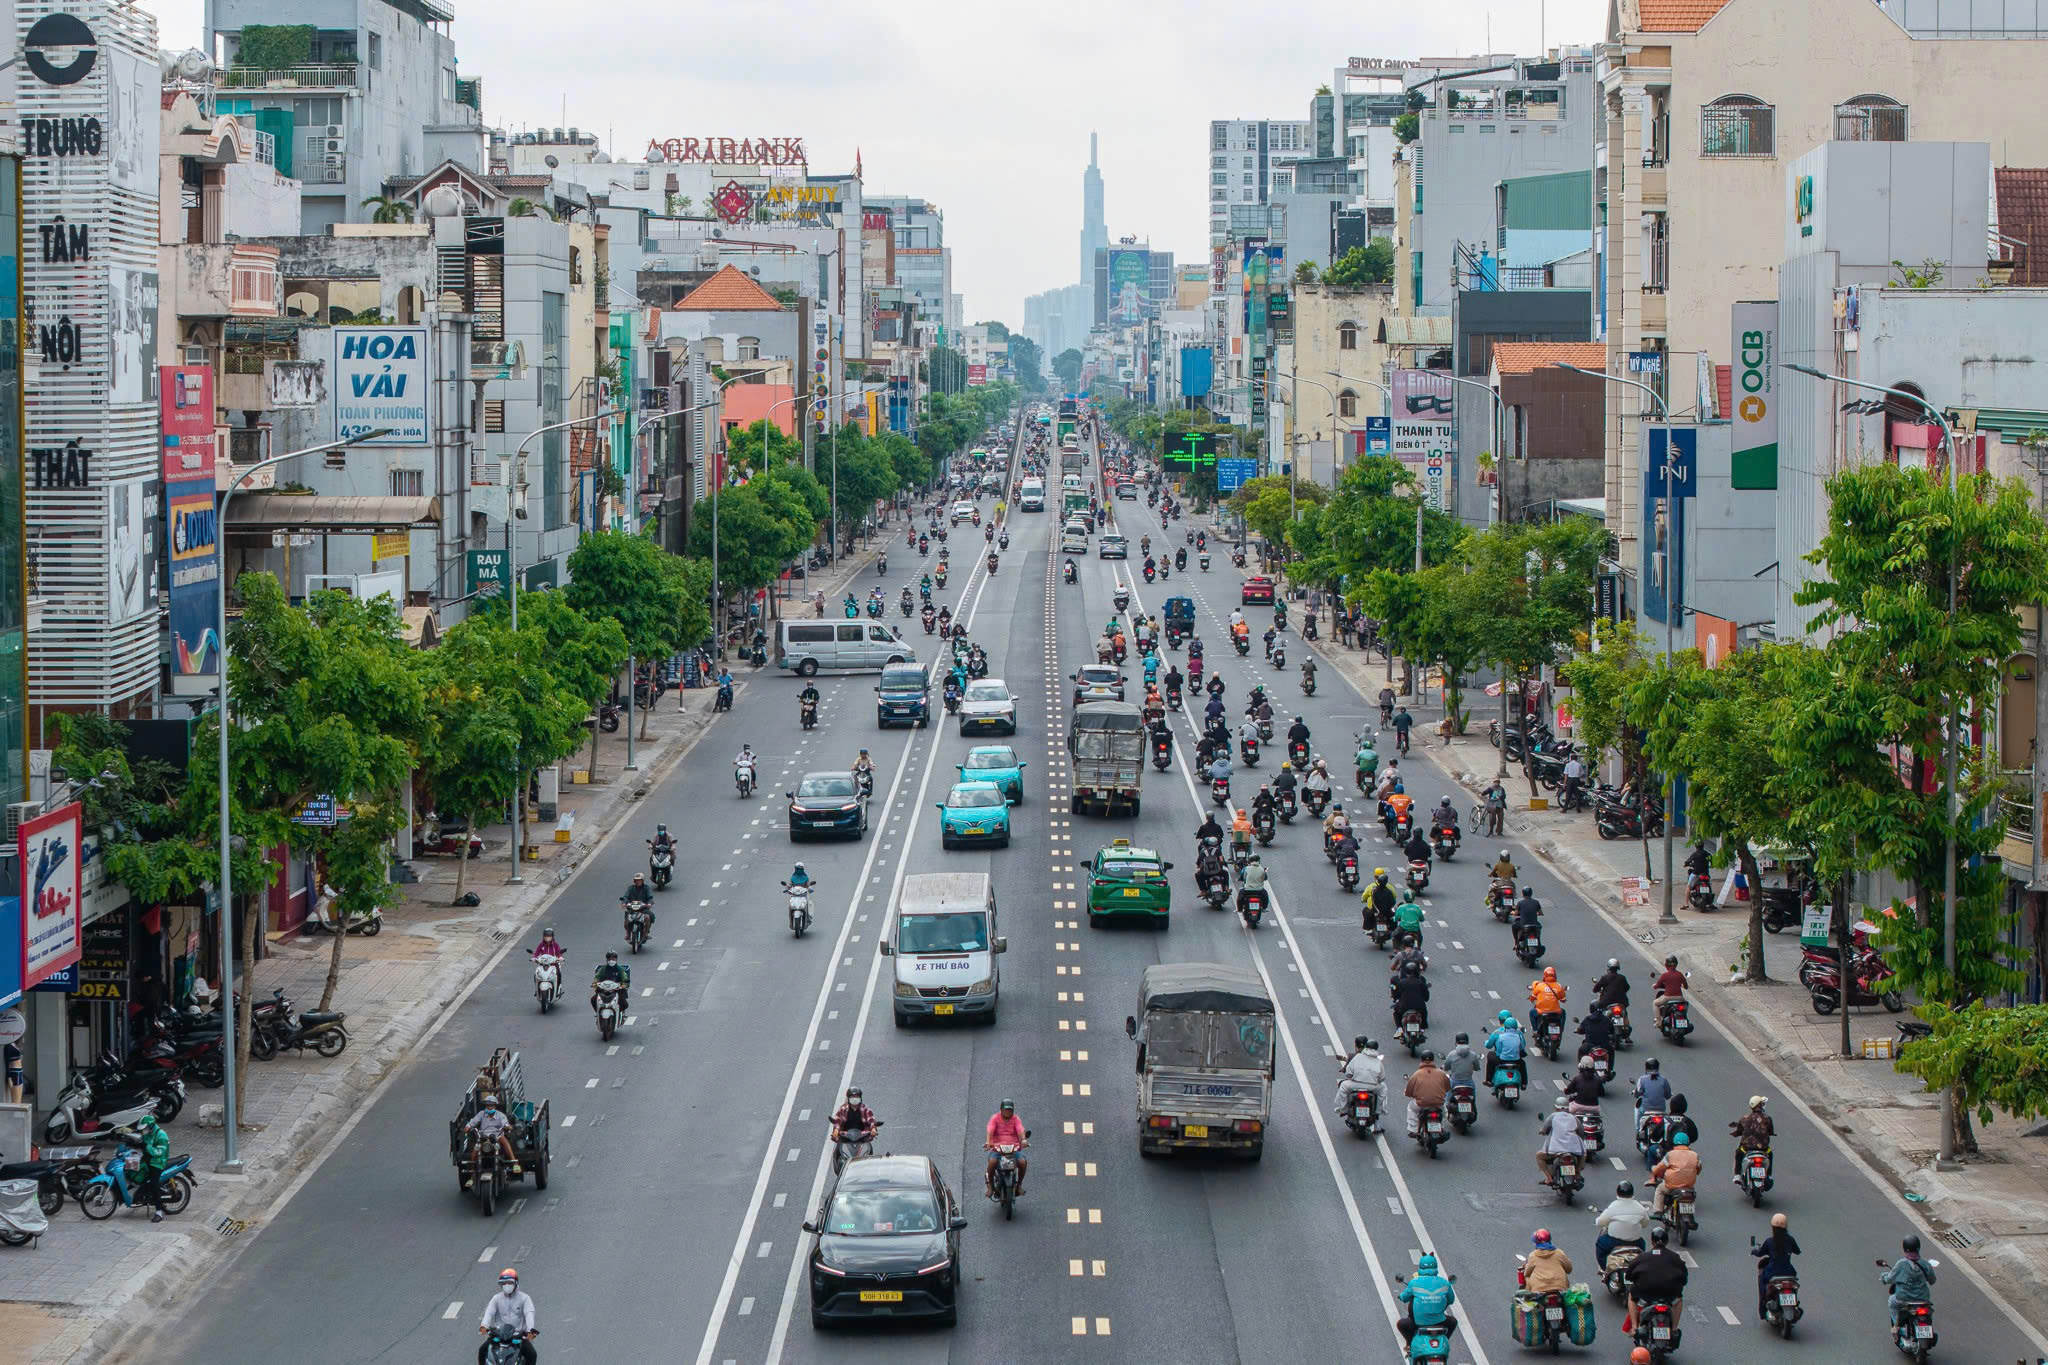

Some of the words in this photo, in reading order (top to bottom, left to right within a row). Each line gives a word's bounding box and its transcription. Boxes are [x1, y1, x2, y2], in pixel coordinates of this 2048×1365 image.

[21, 117, 101, 157] TRUNG
[643, 137, 807, 160] AGRIBANK
[767, 187, 793, 203] AN
[797, 187, 838, 203] HUY
[39, 215, 89, 263] TÂM
[41, 316, 81, 371] NỘI
[342, 335, 416, 359] HOA
[1629, 356, 1640, 371] MỸ
[1741, 331, 1763, 392] OCB
[351, 364, 407, 397] VẢI
[374, 405, 424, 420] PHƯƠNG
[1396, 426, 1432, 436] THANH
[1436, 426, 1452, 436] TU
[31, 436, 93, 487] THẤT
[1660, 465, 1687, 483] PNJ
[184, 509, 214, 551] JOTUN
[477, 554, 501, 565] RAU
[479, 566, 499, 579] MÁ
[915, 963, 927, 971] XE
[930, 961, 948, 970] THƯ
[951, 961, 970, 970] BÁO
